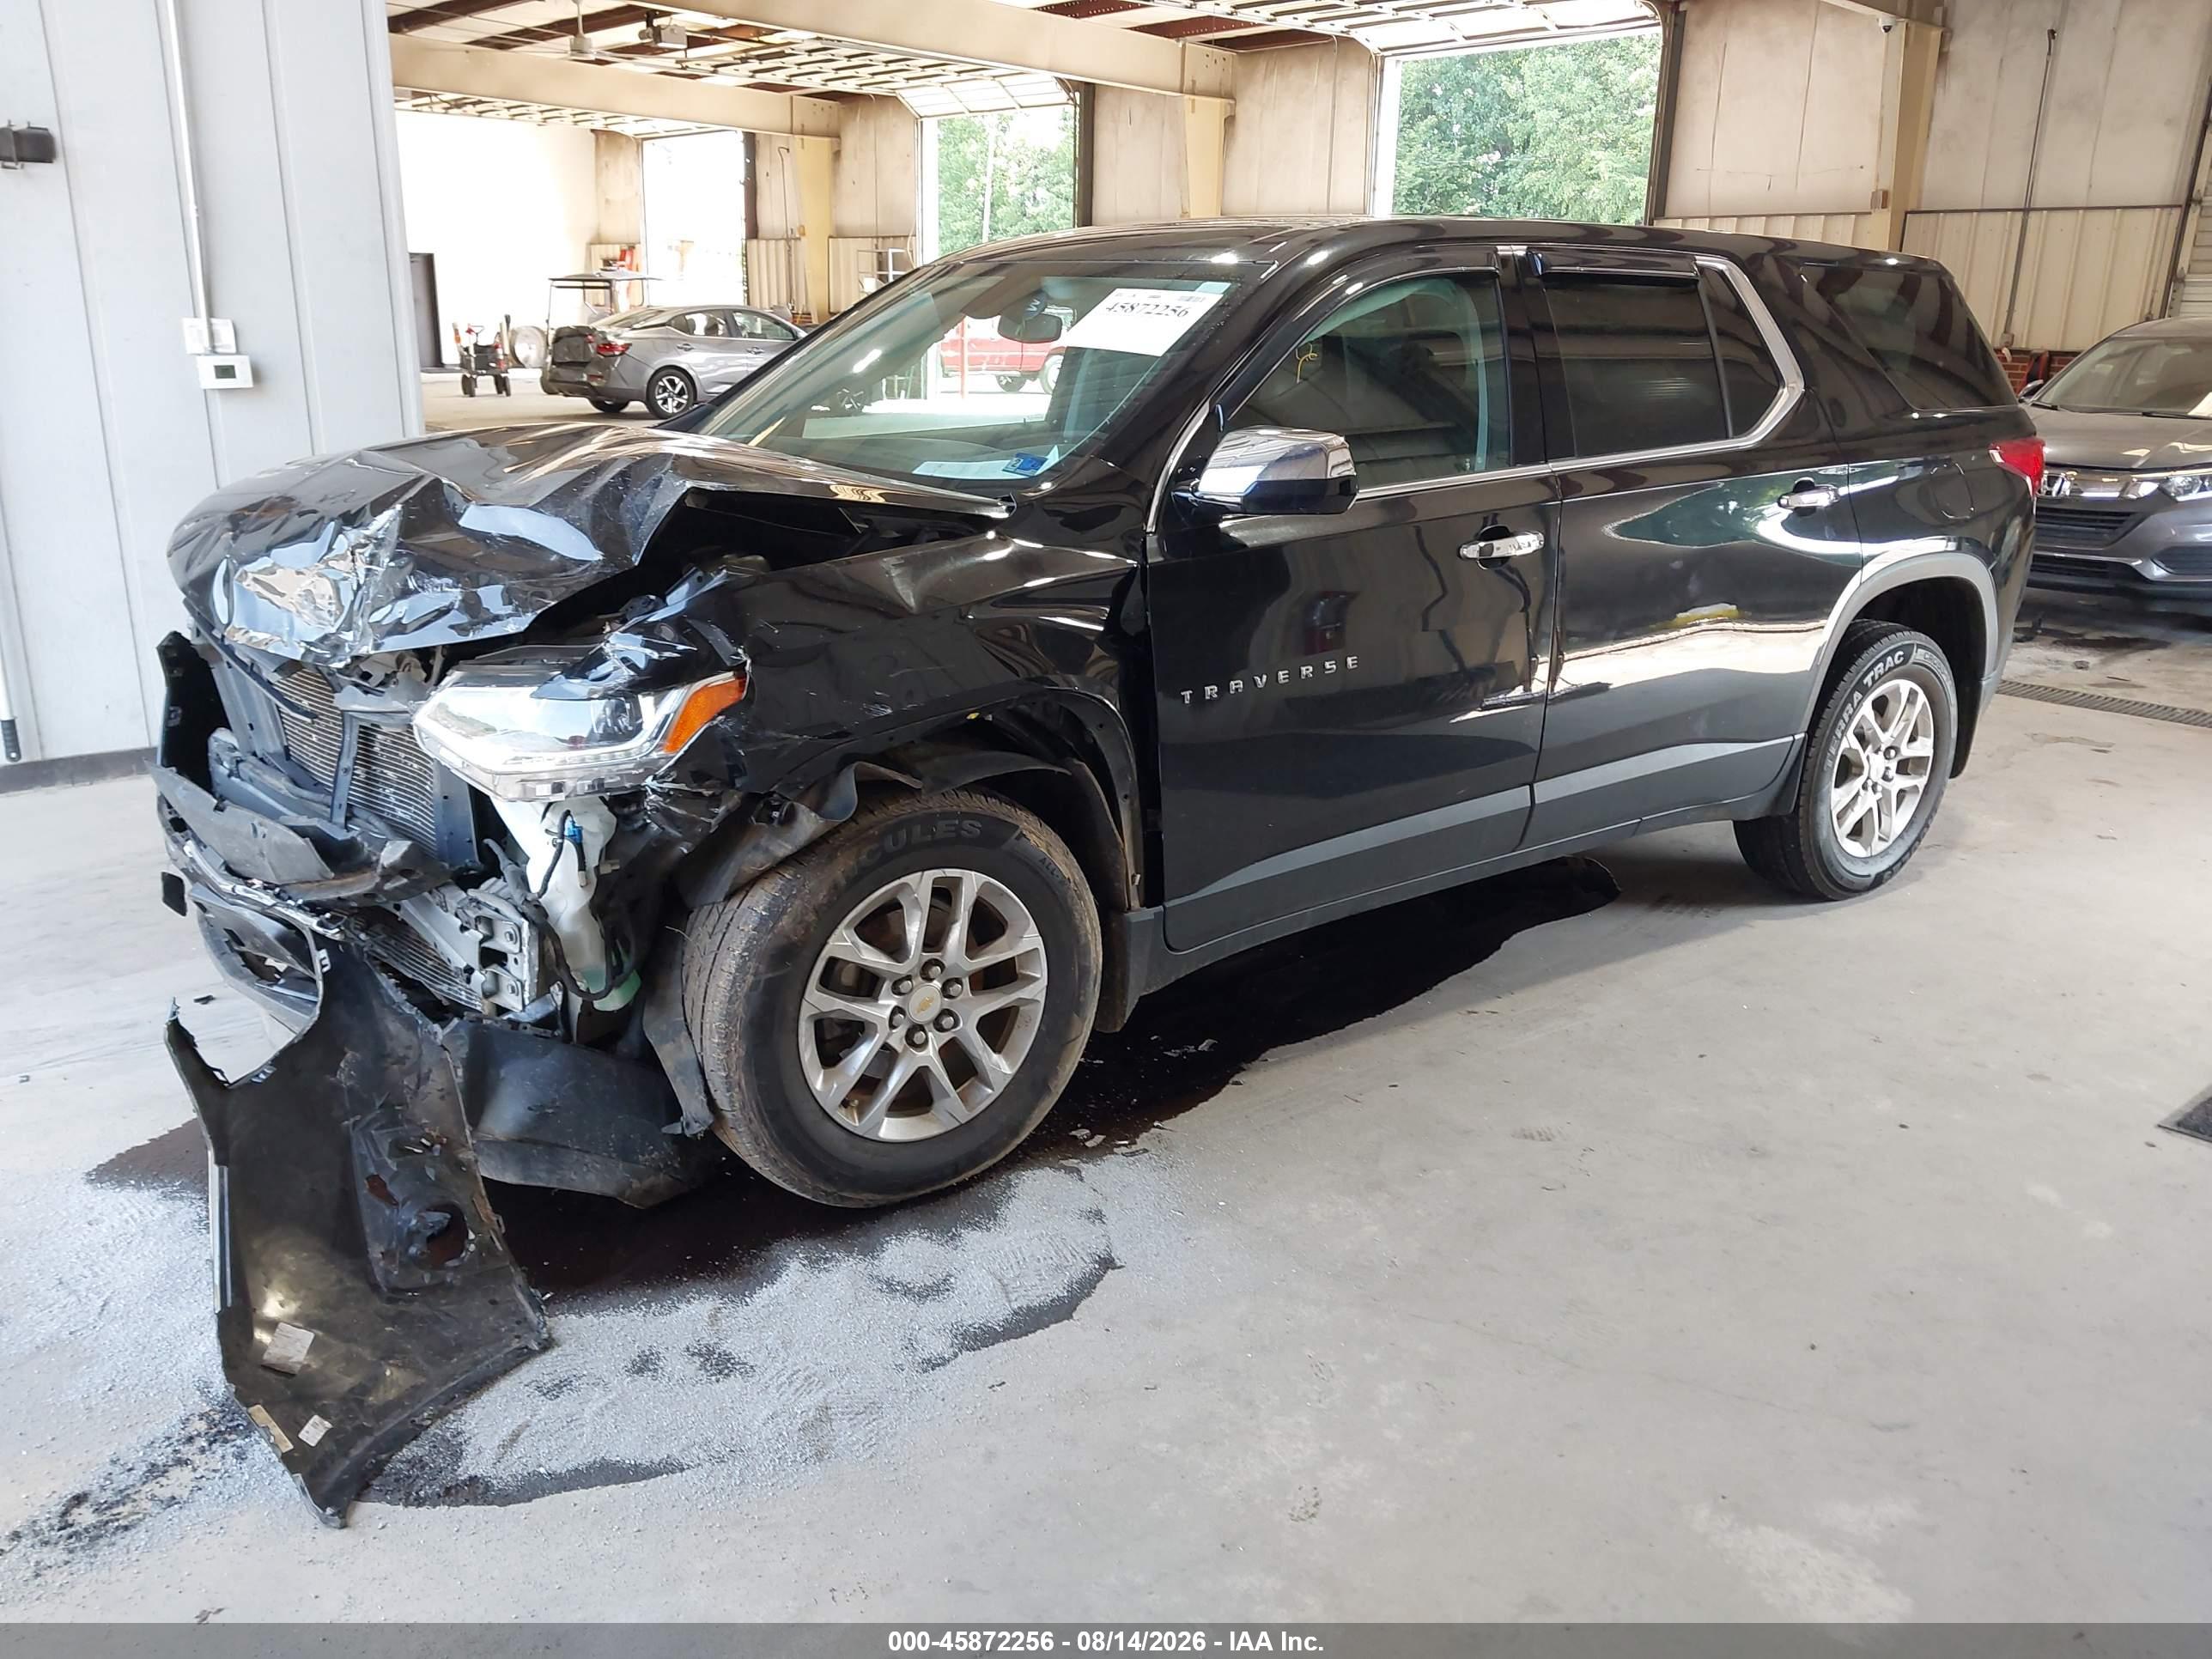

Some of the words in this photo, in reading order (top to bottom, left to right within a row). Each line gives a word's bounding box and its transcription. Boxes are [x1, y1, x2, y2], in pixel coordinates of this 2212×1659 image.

[1105, 301, 1190, 318] 45872256
[1181, 655, 1358, 704] TRAVERSE
[1863, 650, 1905, 688] TRAC
